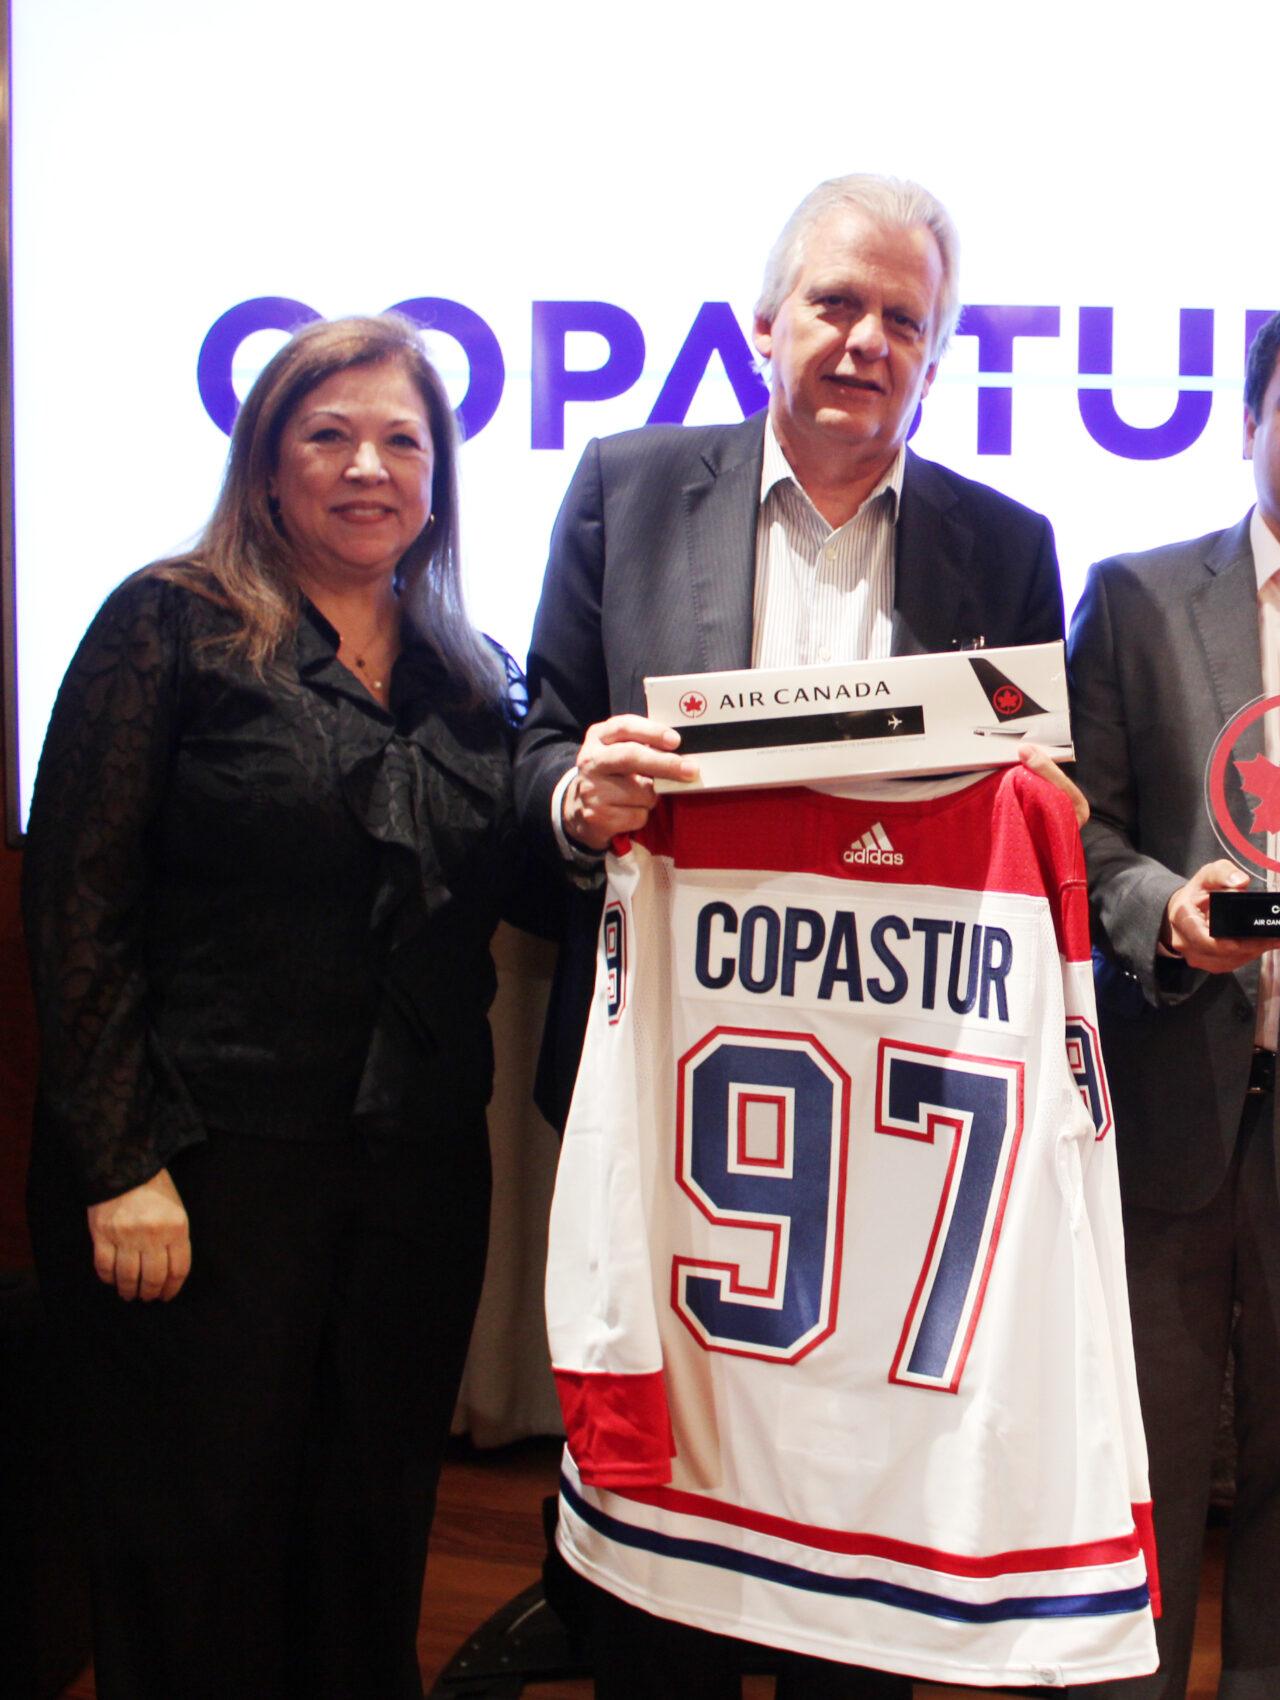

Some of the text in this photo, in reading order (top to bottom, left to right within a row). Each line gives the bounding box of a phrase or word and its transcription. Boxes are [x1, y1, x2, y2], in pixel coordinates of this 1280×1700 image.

[720, 680, 891, 710] AIR CANADA
[843, 848, 904, 866] adidas
[694, 901, 1013, 1022] COPASTUR
[671, 1026, 1025, 1394] 97
